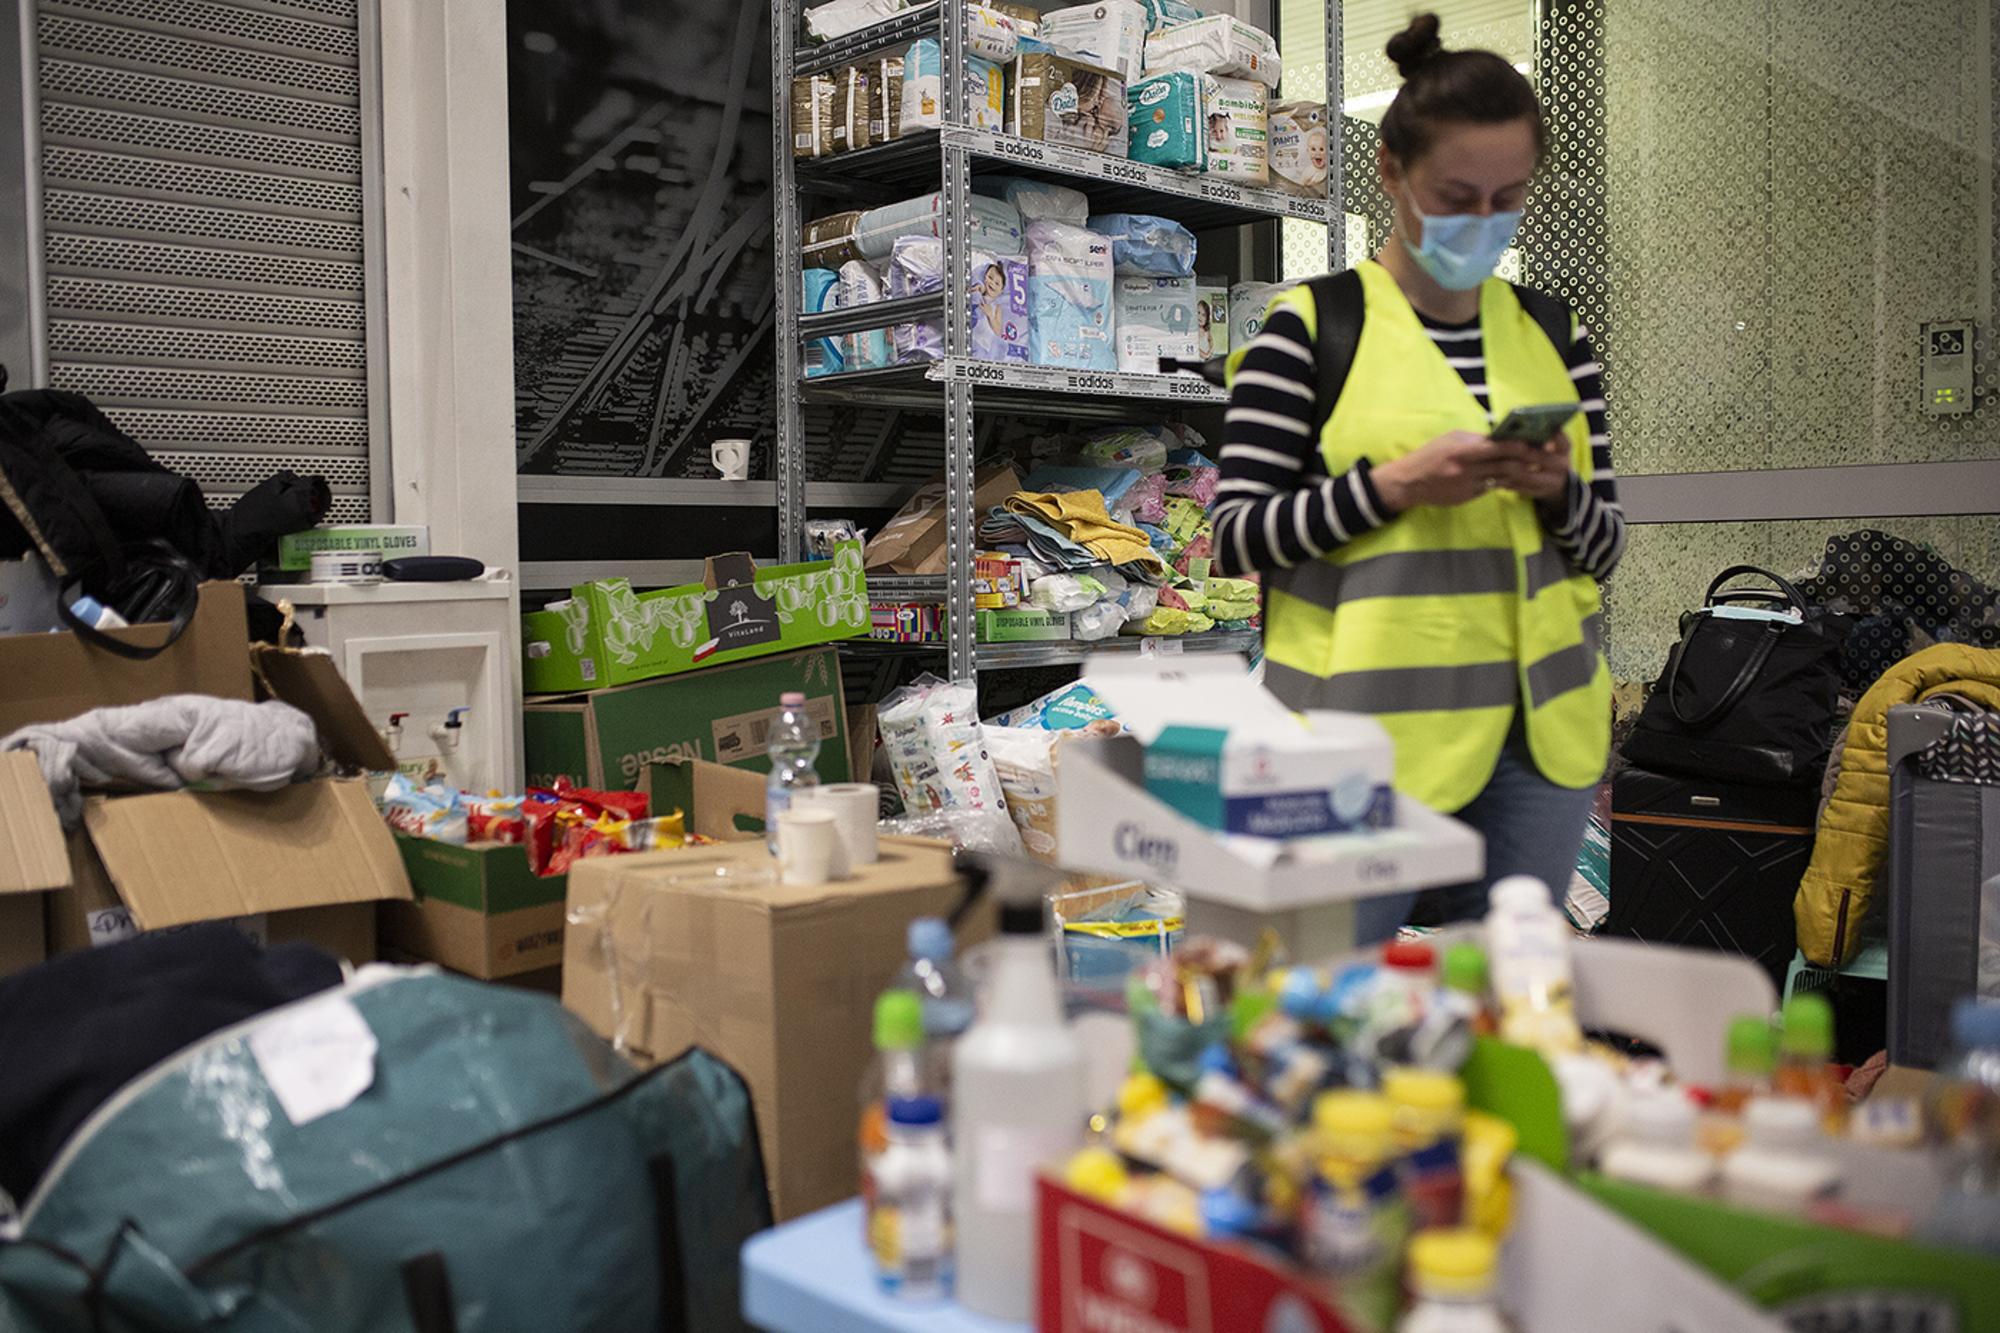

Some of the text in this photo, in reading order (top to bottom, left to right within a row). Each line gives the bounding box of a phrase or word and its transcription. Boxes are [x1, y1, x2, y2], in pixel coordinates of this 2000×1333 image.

[1272, 135, 1300, 146] PANTS
[1005, 141, 1044, 160] adidas
[1112, 165, 1148, 182] adidas
[1209, 185, 1241, 200] adidas
[1296, 200, 1326, 216] adidas
[1012, 273, 1026, 306] 5
[966, 364, 1005, 381] adidas
[1078, 375, 1114, 390] adidas
[1178, 381, 1211, 395] adidas
[294, 535, 417, 550] DISPOSABLE VINYL GLOVES
[996, 616, 1029, 628] DISPOSABLE
